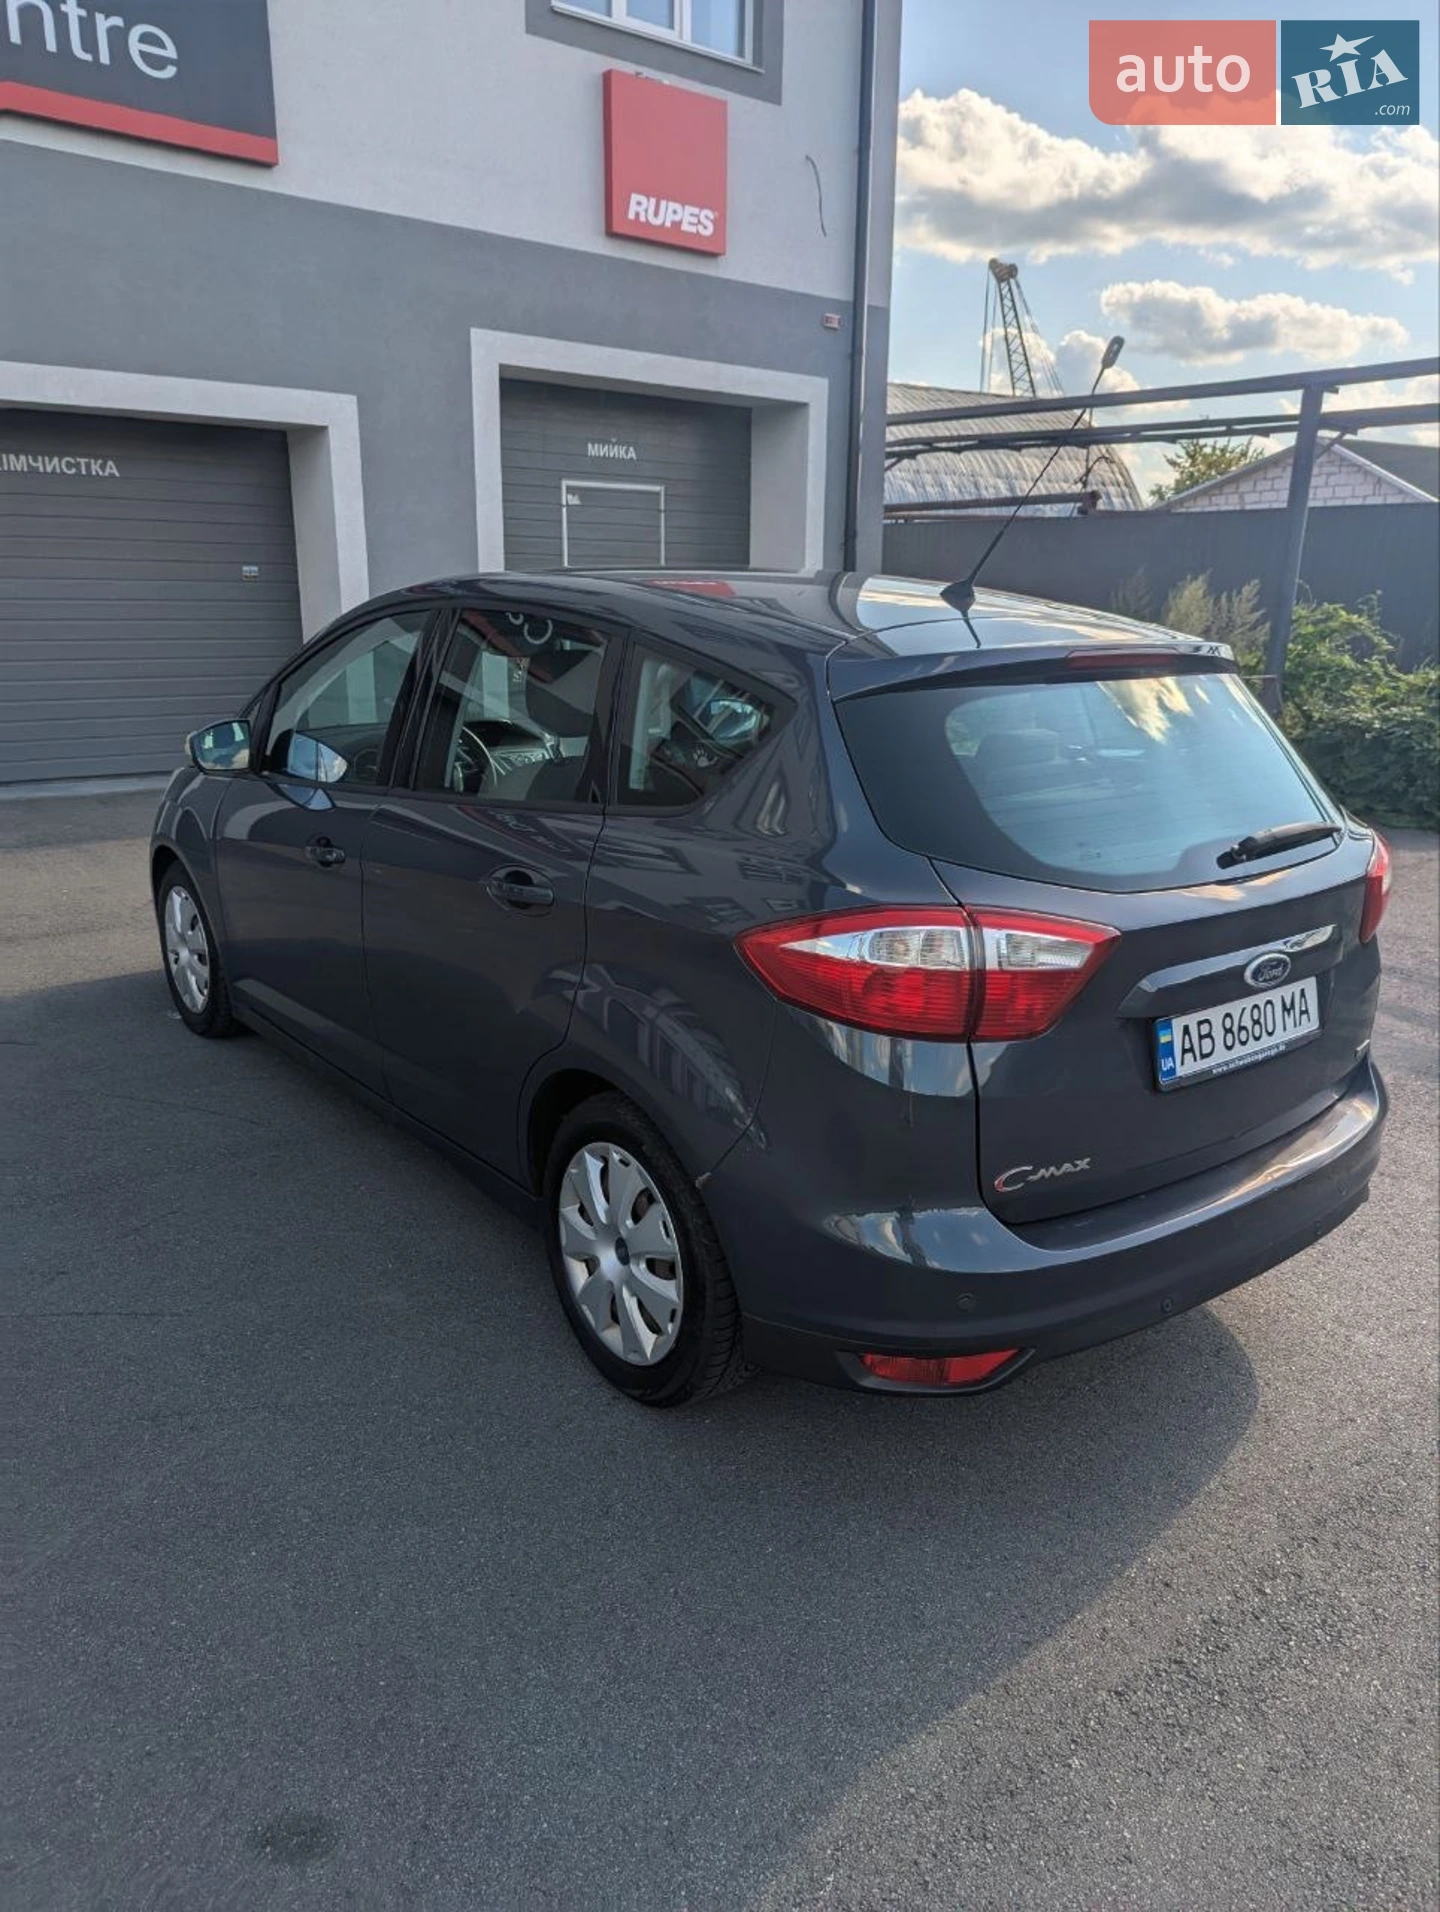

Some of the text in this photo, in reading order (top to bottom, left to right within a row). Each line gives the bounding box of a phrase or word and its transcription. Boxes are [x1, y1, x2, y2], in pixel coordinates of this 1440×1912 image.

[627, 192, 716, 238] RUPES
[587, 438, 637, 460] МИЙКА
[0, 453, 120, 477] ІМЧИСТКА
[1257, 960, 1286, 982] Ford
[1180, 987, 1312, 1067] AB 8680 MA
[1161, 1058, 1175, 1072] UA
